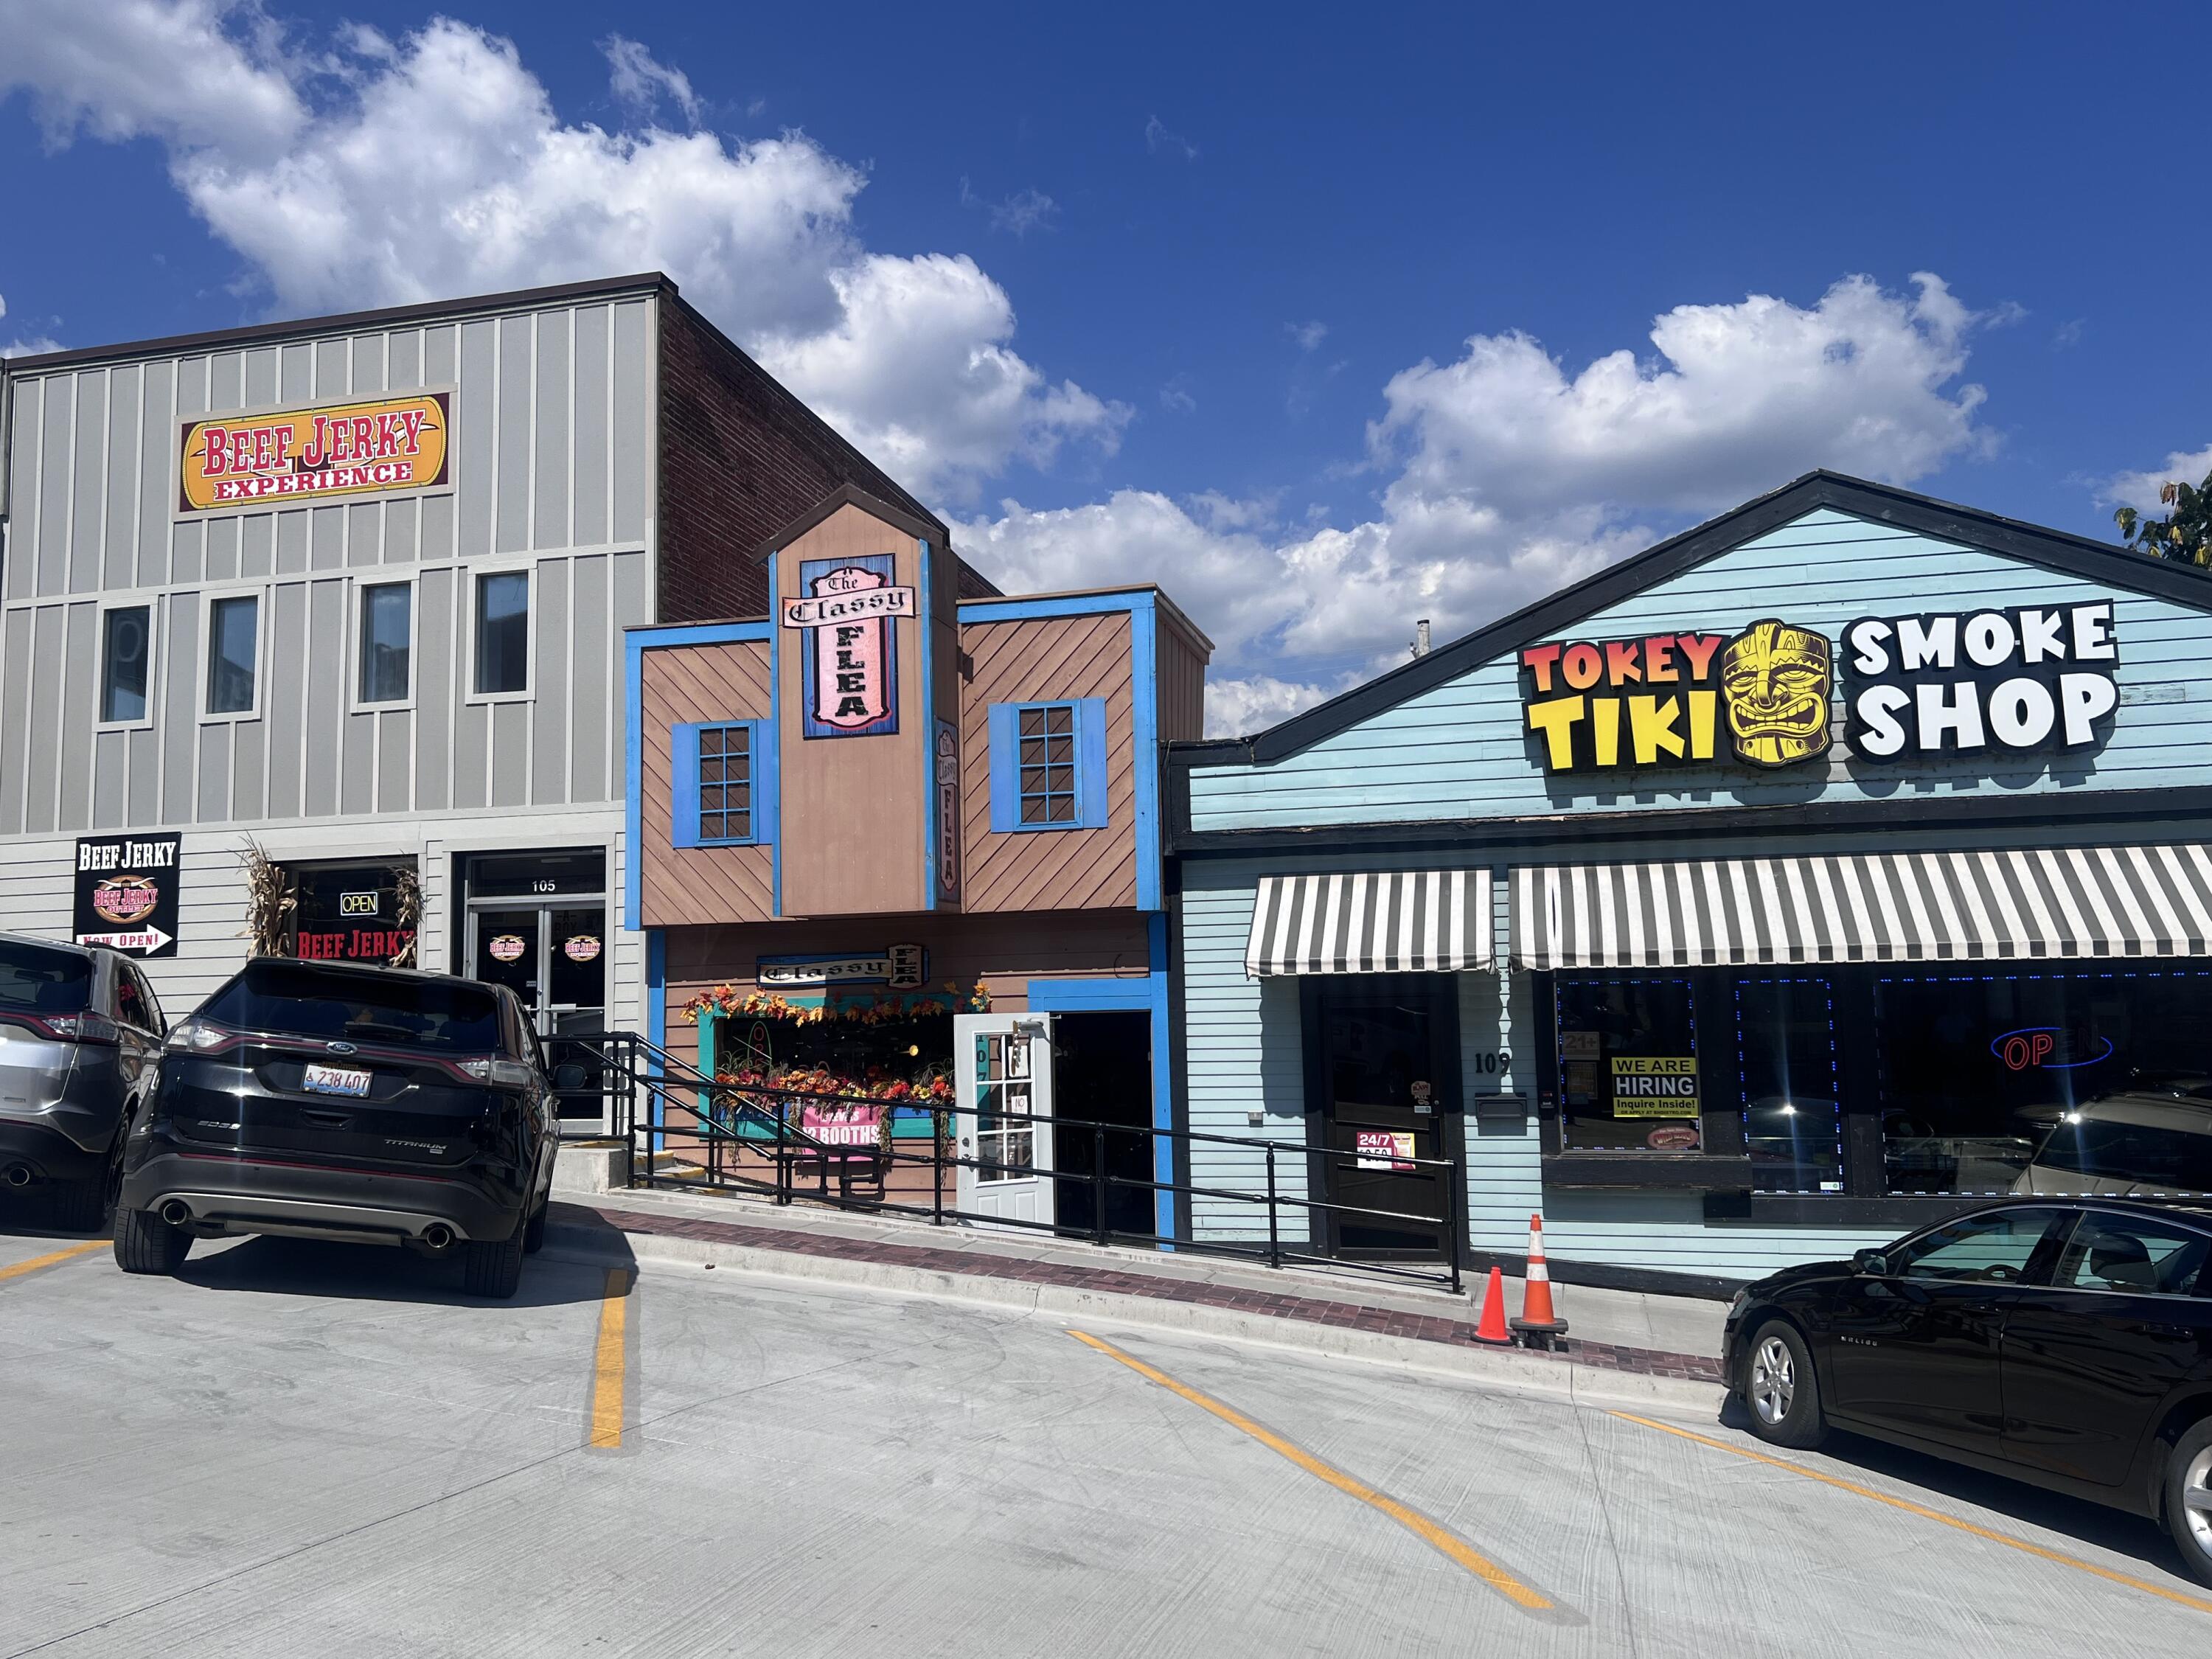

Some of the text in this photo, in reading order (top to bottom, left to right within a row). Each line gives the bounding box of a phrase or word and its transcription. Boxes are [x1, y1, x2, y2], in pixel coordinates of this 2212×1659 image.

[201, 408, 426, 478] BEEF JERKY
[213, 461, 412, 501] EXPERIENCE
[826, 576, 858, 590] The
[789, 591, 905, 622] Classy
[1851, 605, 2116, 676] SMOKE
[835, 626, 869, 717] FLEA
[1523, 634, 1723, 693] TOKEY
[1856, 672, 2117, 757] SHOP
[1528, 690, 1715, 771] TIKI
[944, 789, 953, 881] FLEA
[78, 841, 176, 871] BEEF JERKY
[532, 880, 555, 892] 105
[94, 888, 158, 907] BEEF JERKY
[342, 896, 376, 912] OPEN
[107, 905, 145, 914] OUTLET
[119, 933, 158, 946] OPEN!
[298, 931, 345, 959] BEEF
[490, 942, 505, 953] BEEF
[565, 942, 580, 953] BEEF
[764, 962, 887, 981] Classy
[894, 948, 919, 984] FLEA
[1565, 1034, 1596, 1049] 21+
[1475, 1052, 1511, 1077] 109
[1616, 1060, 1691, 1072] WE ARE
[317, 1071, 369, 1091] 238 407
[1615, 1077, 1694, 1096] HIRING
[1015, 1097, 1025, 1107] NO
[1617, 1099, 1695, 1110] Inquire Inside!
[384, 1138, 448, 1150] TITANIUM
[820, 1125, 880, 1144] BOOTHS
[1360, 1134, 1391, 1146] 24/7
